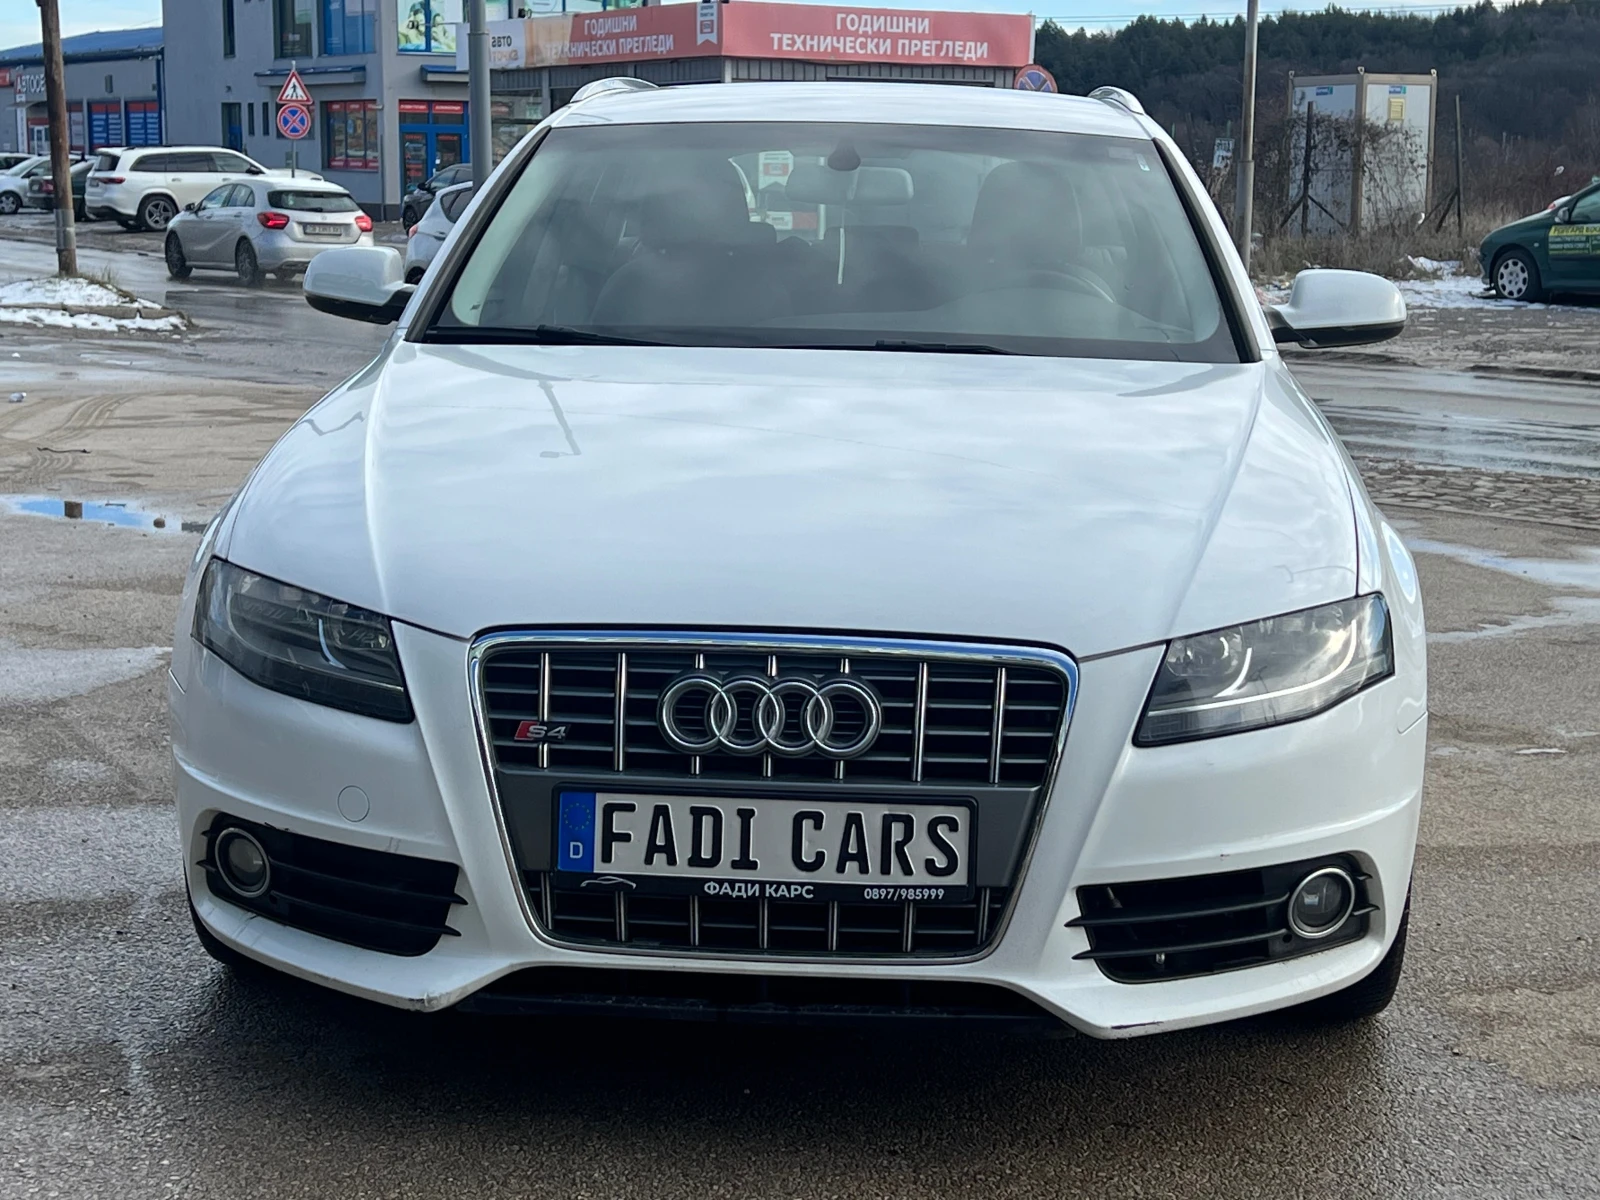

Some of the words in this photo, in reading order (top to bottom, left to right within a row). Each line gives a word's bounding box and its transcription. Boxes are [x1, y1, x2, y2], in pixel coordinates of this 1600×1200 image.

[584, 15, 638, 37] ГОДИШНИ
[836, 13, 930, 34] ГОДИШНИ
[618, 34, 674, 54] ПРЕГЛЕДИ
[770, 33, 891, 55] ТЕХНИЧЕСКИ
[897, 39, 988, 61] ПРЕГЛЕДИ
[526, 725, 567, 739] S4
[601, 802, 759, 871] FADI
[791, 810, 960, 877] CARS
[569, 841, 584, 859] D
[703, 881, 760, 899] ФАДИ
[765, 884, 814, 899] КАРС
[863, 888, 945, 901] 0897/985999
